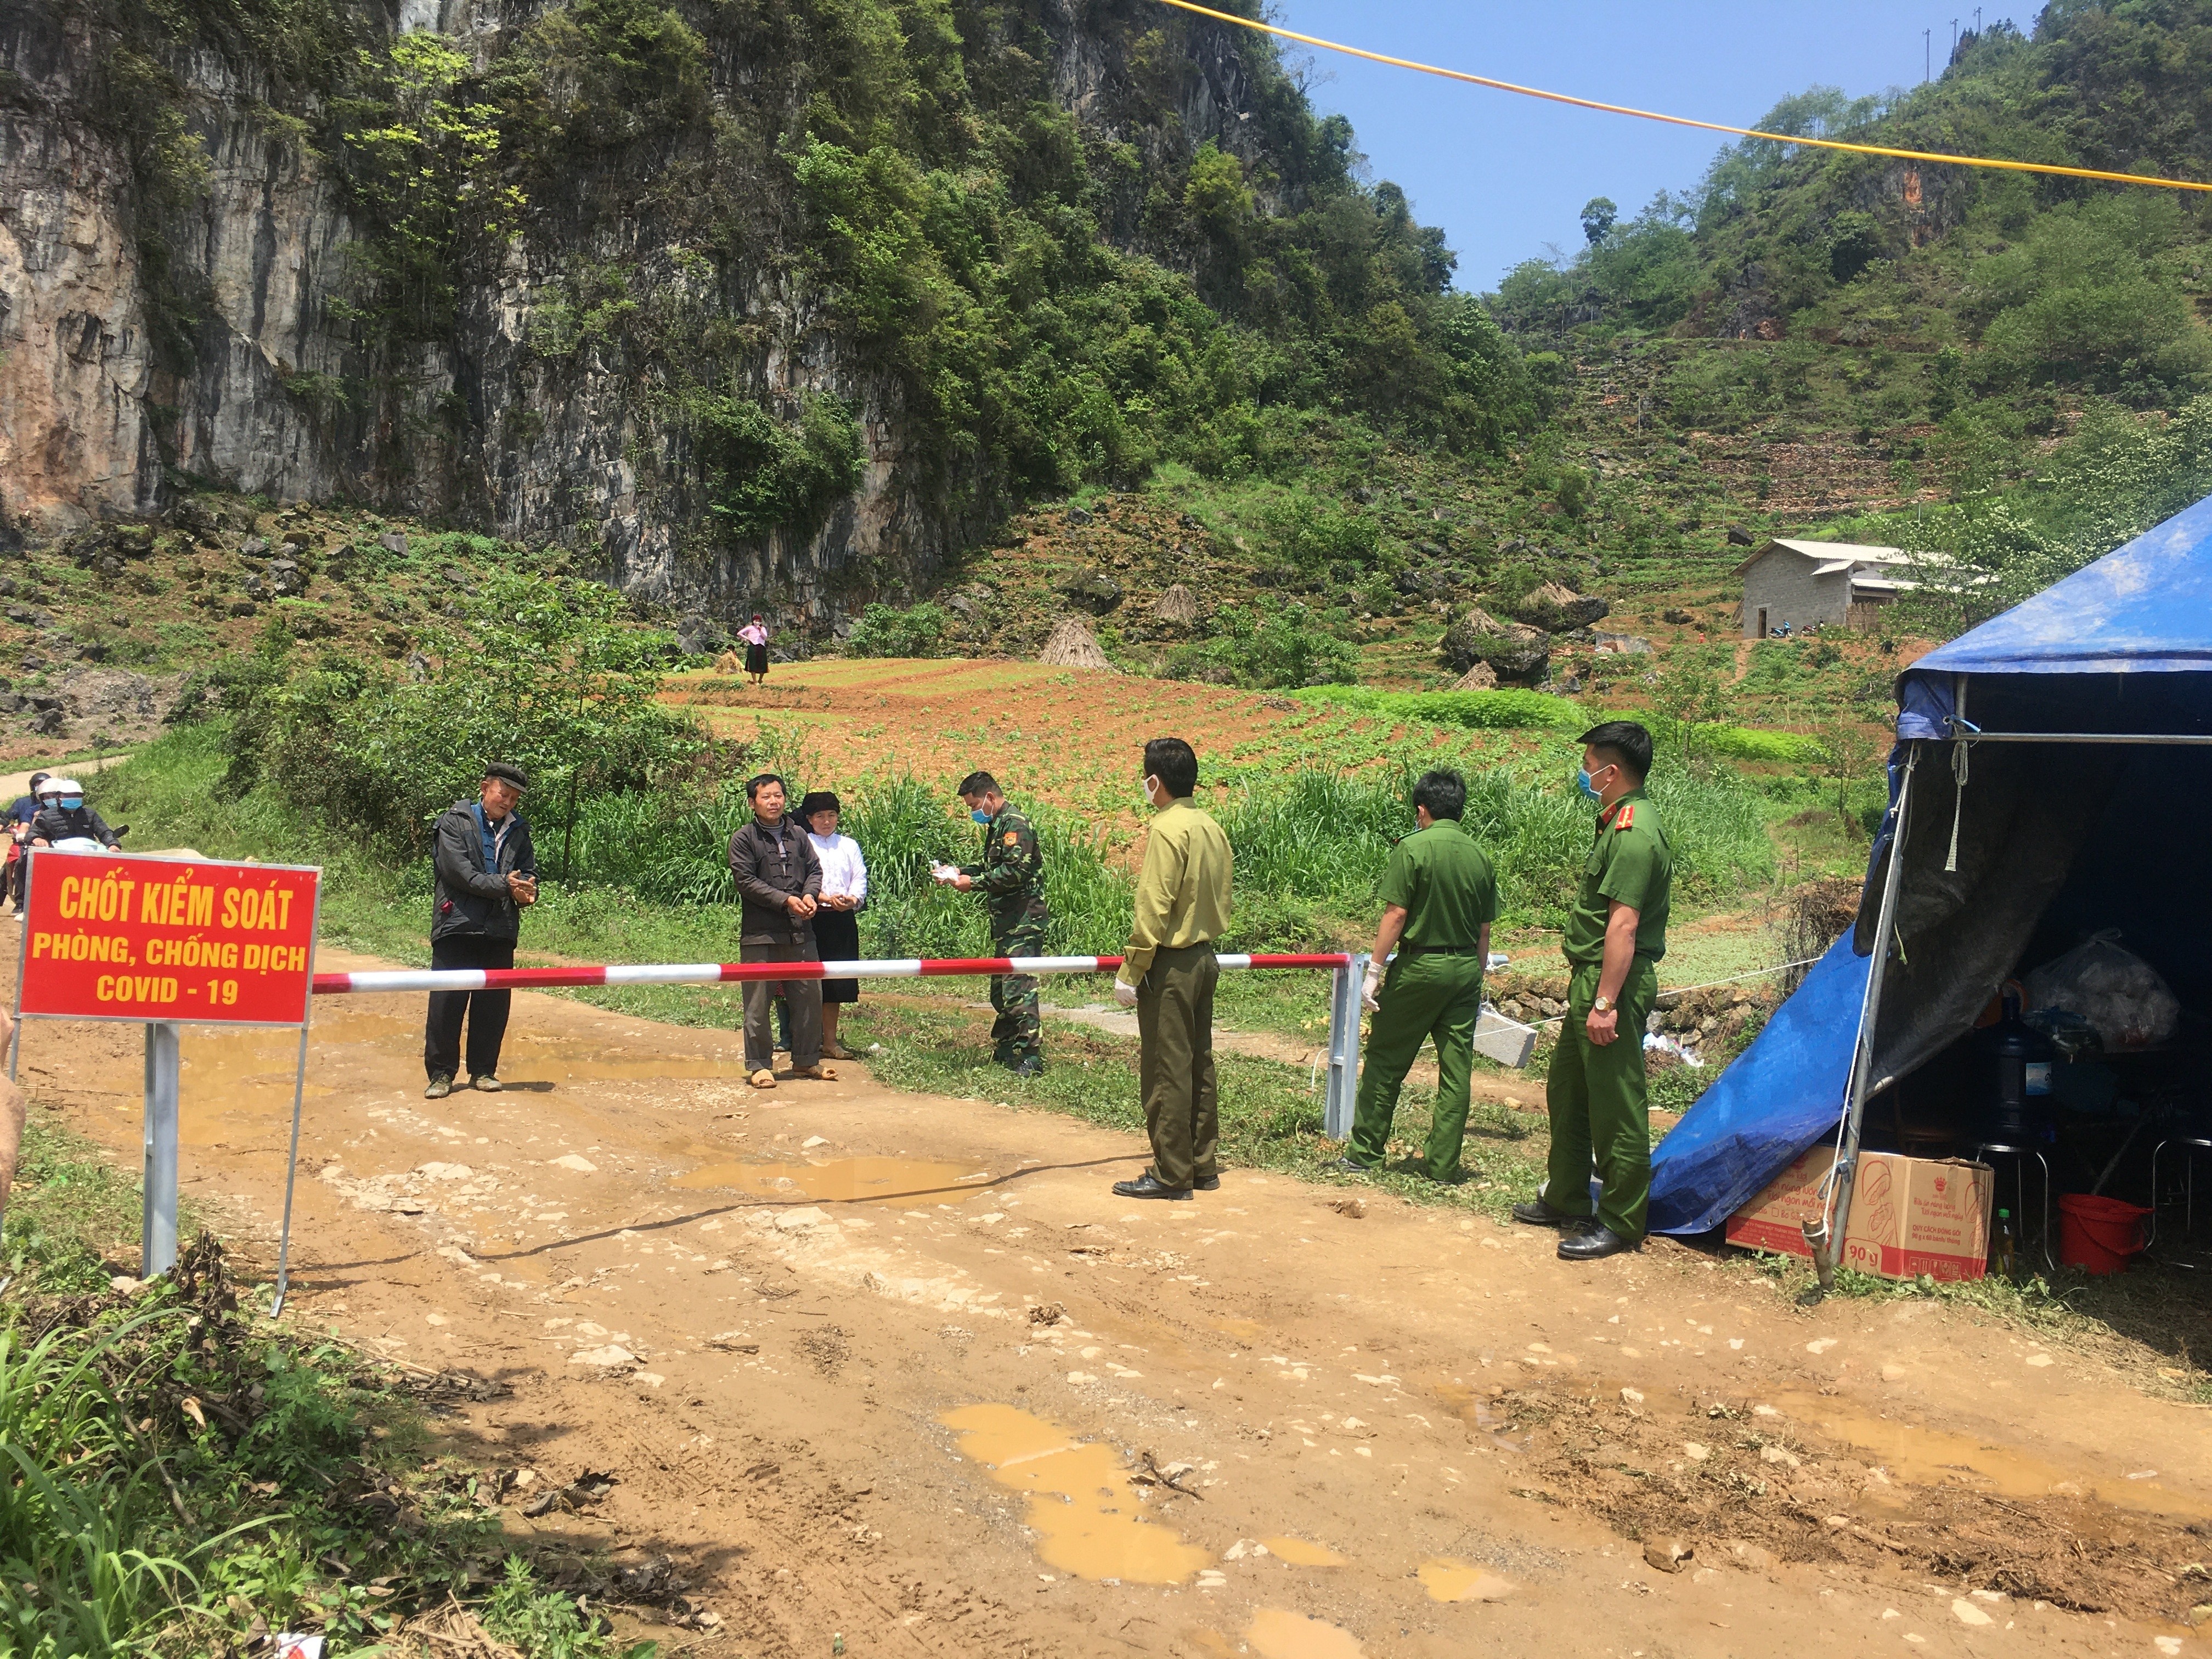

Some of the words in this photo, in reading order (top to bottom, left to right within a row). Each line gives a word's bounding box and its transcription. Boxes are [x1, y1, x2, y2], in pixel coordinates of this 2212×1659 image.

[60, 867, 135, 922] CHỐT
[141, 868, 214, 927] KIỂM
[221, 880, 294, 930] SOÁT
[32, 928, 136, 966] PHÒNG,
[146, 933, 239, 968] CHỐNG
[243, 944, 306, 975] DỊCH
[97, 975, 178, 1003] COVID
[207, 980, 238, 1005] 19
[1849, 1245, 1866, 1261] 90
[1869, 1252, 1878, 1267] g
